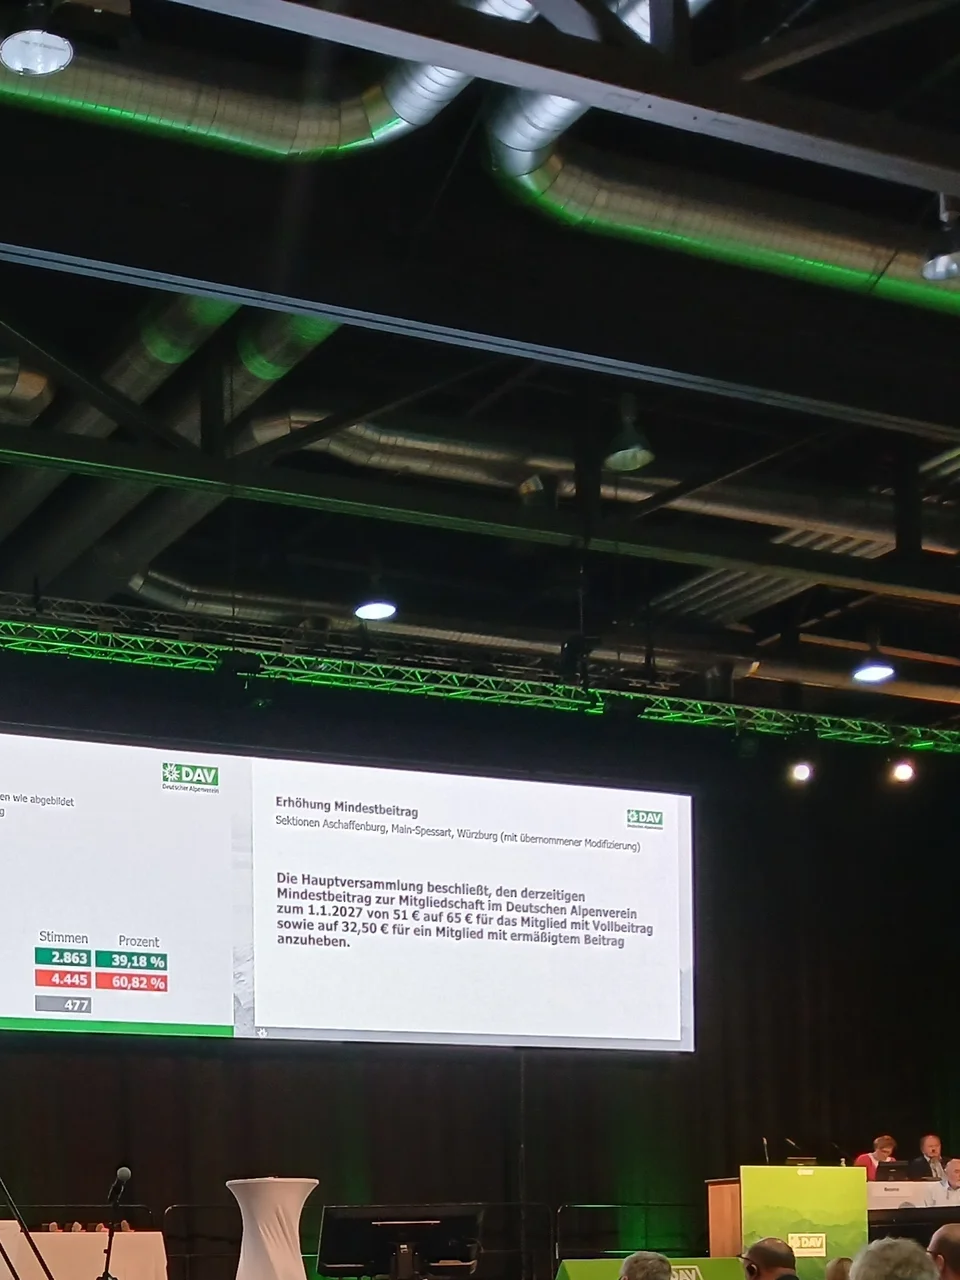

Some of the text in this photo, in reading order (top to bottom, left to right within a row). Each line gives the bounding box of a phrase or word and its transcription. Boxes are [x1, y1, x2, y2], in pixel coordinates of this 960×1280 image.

[181, 766, 217, 783] DAV
[13, 794, 28, 804] wie
[30, 794, 74, 807] abgebildet
[276, 796, 418, 820] Erhöhung Mindestbeitrag
[639, 812, 662, 824] DAV
[276, 815, 641, 853] Sektionen Aschaffenburg, Main-Spessart, Würzburg (mit übernommener Modifizierung)
[276, 872, 586, 904] Die Hauptversammlung beschließt, den derzeitigen
[277, 887, 638, 920] Mindestbeitrag zur Mitgliedschaft im Deutschen Alpenverein
[276, 904, 654, 936] zum 1.1.2027 von 51 € auf 65 € für das Mitglied mit Vollbeitrag
[39, 930, 160, 948] Stimmen Prozent
[277, 918, 625, 949] sowie auf 32,50 € für ein Mitglied mit ermäßigtem Beitrag
[277, 934, 350, 948] anzuheben.
[51, 950, 88, 965] 2.863
[111, 954, 148, 970] 39,18
[150, 955, 166, 969] %
[51, 972, 88, 987] 4.445
[112, 975, 148, 991] 60,82
[150, 976, 166, 990] %
[64, 997, 89, 1012] 477
[800, 1237, 823, 1248] DAV
